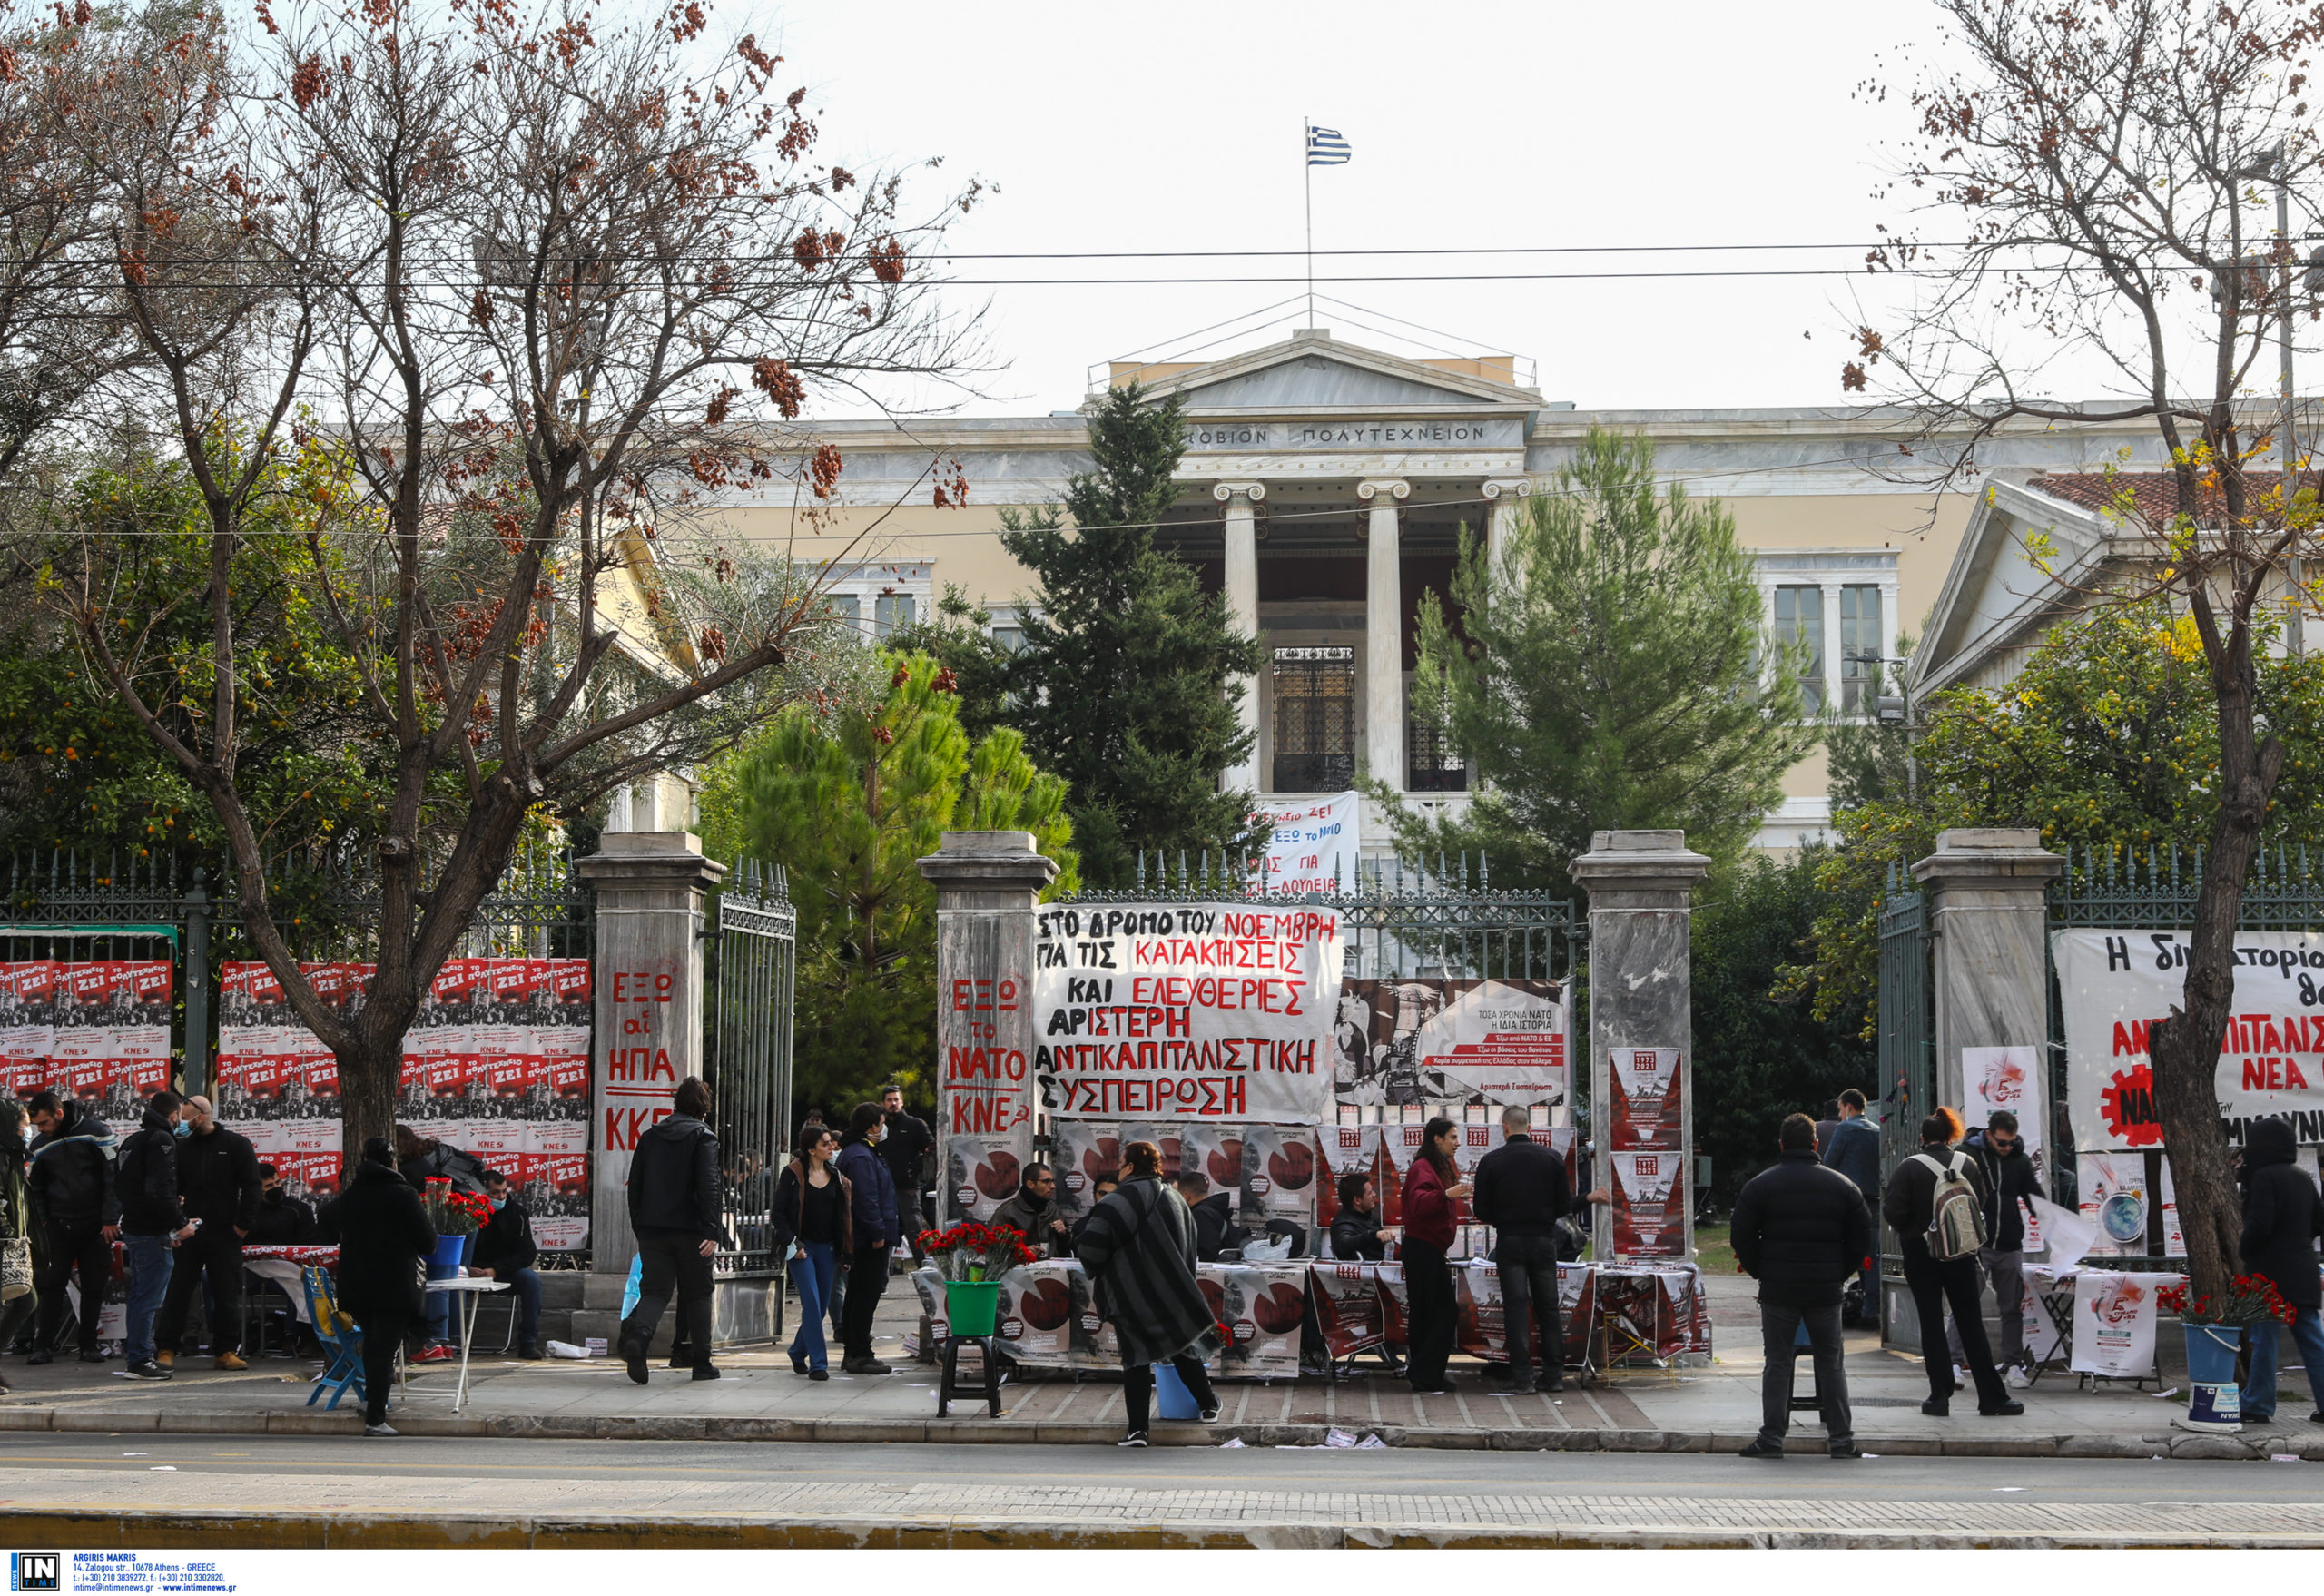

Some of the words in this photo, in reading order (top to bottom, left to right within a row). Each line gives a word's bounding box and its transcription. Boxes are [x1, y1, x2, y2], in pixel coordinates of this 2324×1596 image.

[1303, 427, 1484, 443] ΠΟΛΥΤΕΧΝΕΙΟΝ
[1309, 804, 1332, 819] ΖΕΙ
[1275, 830, 1300, 842] ΕΞΩ
[1300, 855, 1318, 869] ΓΙΑ
[1038, 911, 1079, 939] ΣΤΟ
[1088, 910, 1173, 939] ΔΡΟΜΟ
[1177, 910, 1216, 936] ΤΟΥ
[1225, 912, 1335, 943] ΝΟΕΜΒΡΗ
[1037, 942, 1068, 970] ΓΙΑ
[1078, 941, 1117, 969] ΤΙΣ
[1135, 939, 1304, 974] ΚΑΤΑΚΤΗΣΕΙΣ
[2105, 936, 2131, 972] Η
[22, 973, 48, 991] ΖΕΙ
[78, 974, 105, 991] ΖΕΙ
[139, 974, 167, 990] ΖΕΙ
[318, 977, 342, 992] ΖΕΙ
[438, 973, 464, 990] ΖΕΙ
[497, 973, 525, 989] ΖΕΙ
[559, 974, 586, 990] ΖΕΙ
[613, 972, 673, 1002] ΕΞΩ
[953, 980, 1017, 1011] ΕΞΩ
[1068, 976, 1113, 1003] ΚΑΙ
[1133, 977, 1307, 1016] ΕΛΕΥΘΕΡΙΕΣ
[1047, 1005, 1191, 1038] ΑΡΙΣΤΕΡΗ
[1479, 1010, 1497, 1020] ΤΟΣΑ
[1499, 1010, 1528, 1019] ΧΡΟΝΙΑ
[1529, 1010, 1552, 1019] ΝΑΤΟ
[1499, 1020, 1517, 1030] ΙΔΙΑ
[1519, 1020, 1552, 1030] ΙΣΤΟΡΙΑ
[608, 1048, 675, 1082] ΗΠΑ
[949, 1047, 1026, 1081] ΝΑΤΟ
[1035, 1038, 1315, 1075] ΑΝΤΙΚΑΠΙΤΑΛΙΣΤΙΚΗ
[16, 1071, 43, 1087] ΖΕΙ
[75, 1069, 103, 1086] ΖΕΙ
[138, 1069, 165, 1085] ΖΕΙ
[249, 1069, 276, 1085] ΖΕΙ
[310, 1067, 338, 1084] ΖΕΙ
[432, 1067, 459, 1084] ΖΕΙ
[494, 1067, 522, 1083] ΖΕΙ
[557, 1069, 586, 1085] ΖΕΙ
[2242, 1057, 2309, 1090] ΝΕΑ
[1038, 1074, 1246, 1115] ΣΥΣΠΕΙΡΩΣΗ
[953, 1095, 1011, 1134] ΚΝΕ
[310, 1163, 337, 1179] ΖΕΙ
[556, 1165, 584, 1180] ΖΕΙ
